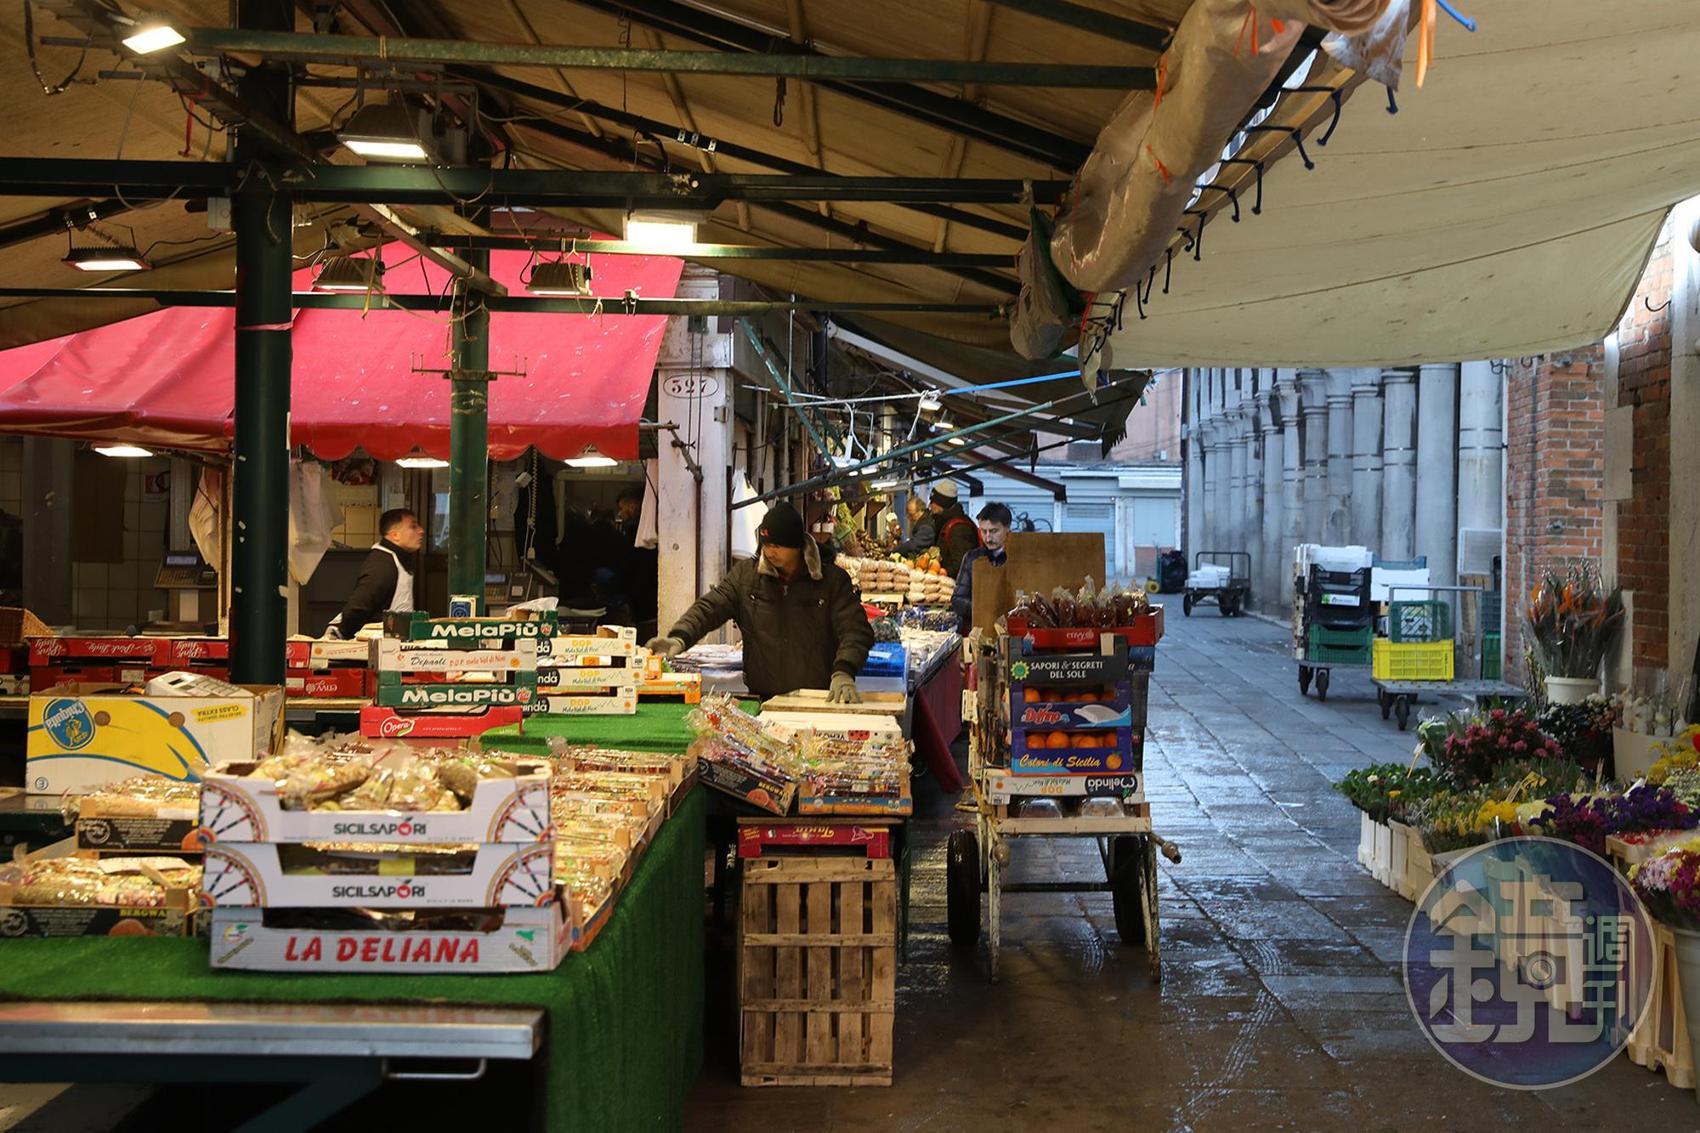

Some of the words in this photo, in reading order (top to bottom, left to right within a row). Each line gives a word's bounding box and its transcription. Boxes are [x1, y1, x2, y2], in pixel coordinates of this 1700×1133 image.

[671, 379, 707, 394] 527
[431, 622, 539, 637] MelaPiù
[1030, 661, 1060, 670] SAPORI
[1061, 661, 1072, 670] &
[1072, 661, 1104, 669] SEGRETI
[1050, 671, 1064, 679] DEL
[1066, 671, 1086, 679] SOLE
[401, 688, 515, 703] MelaPiù
[44, 701, 85, 729] Chiquita
[1066, 755, 1101, 767] Sicilia
[1088, 776, 1135, 788] Melinda
[333, 821, 427, 836] SICILSAPORI
[332, 884, 425, 899] SICILSAPORI
[284, 936, 323, 962] LA
[336, 937, 480, 963] DELIANA
